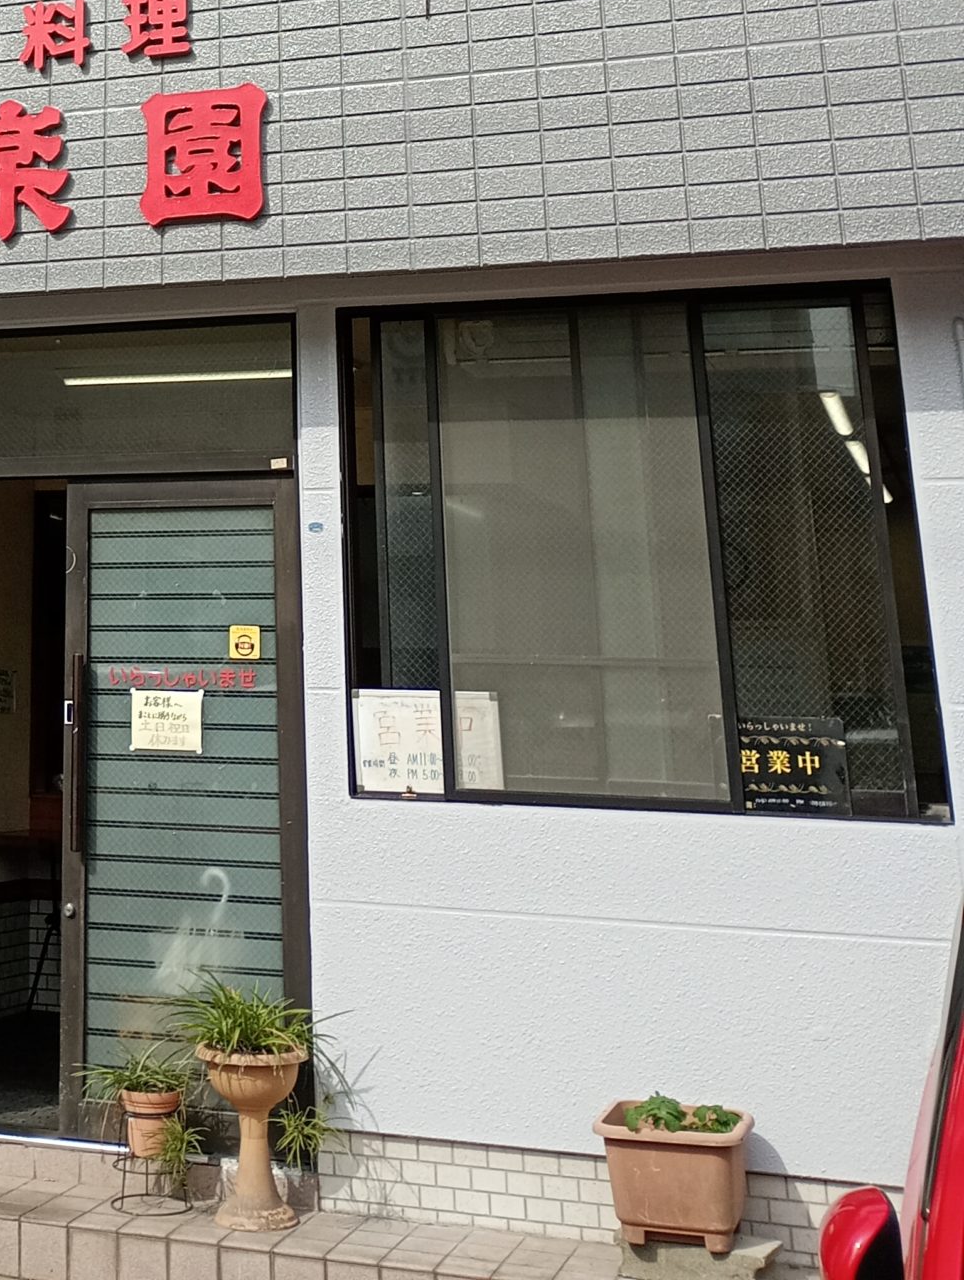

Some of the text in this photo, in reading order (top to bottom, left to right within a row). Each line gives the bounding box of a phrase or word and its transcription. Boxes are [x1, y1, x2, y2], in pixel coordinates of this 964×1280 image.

[109, 666, 258, 689] いらっしゃいませ
[740, 749, 821, 776] 営業中
